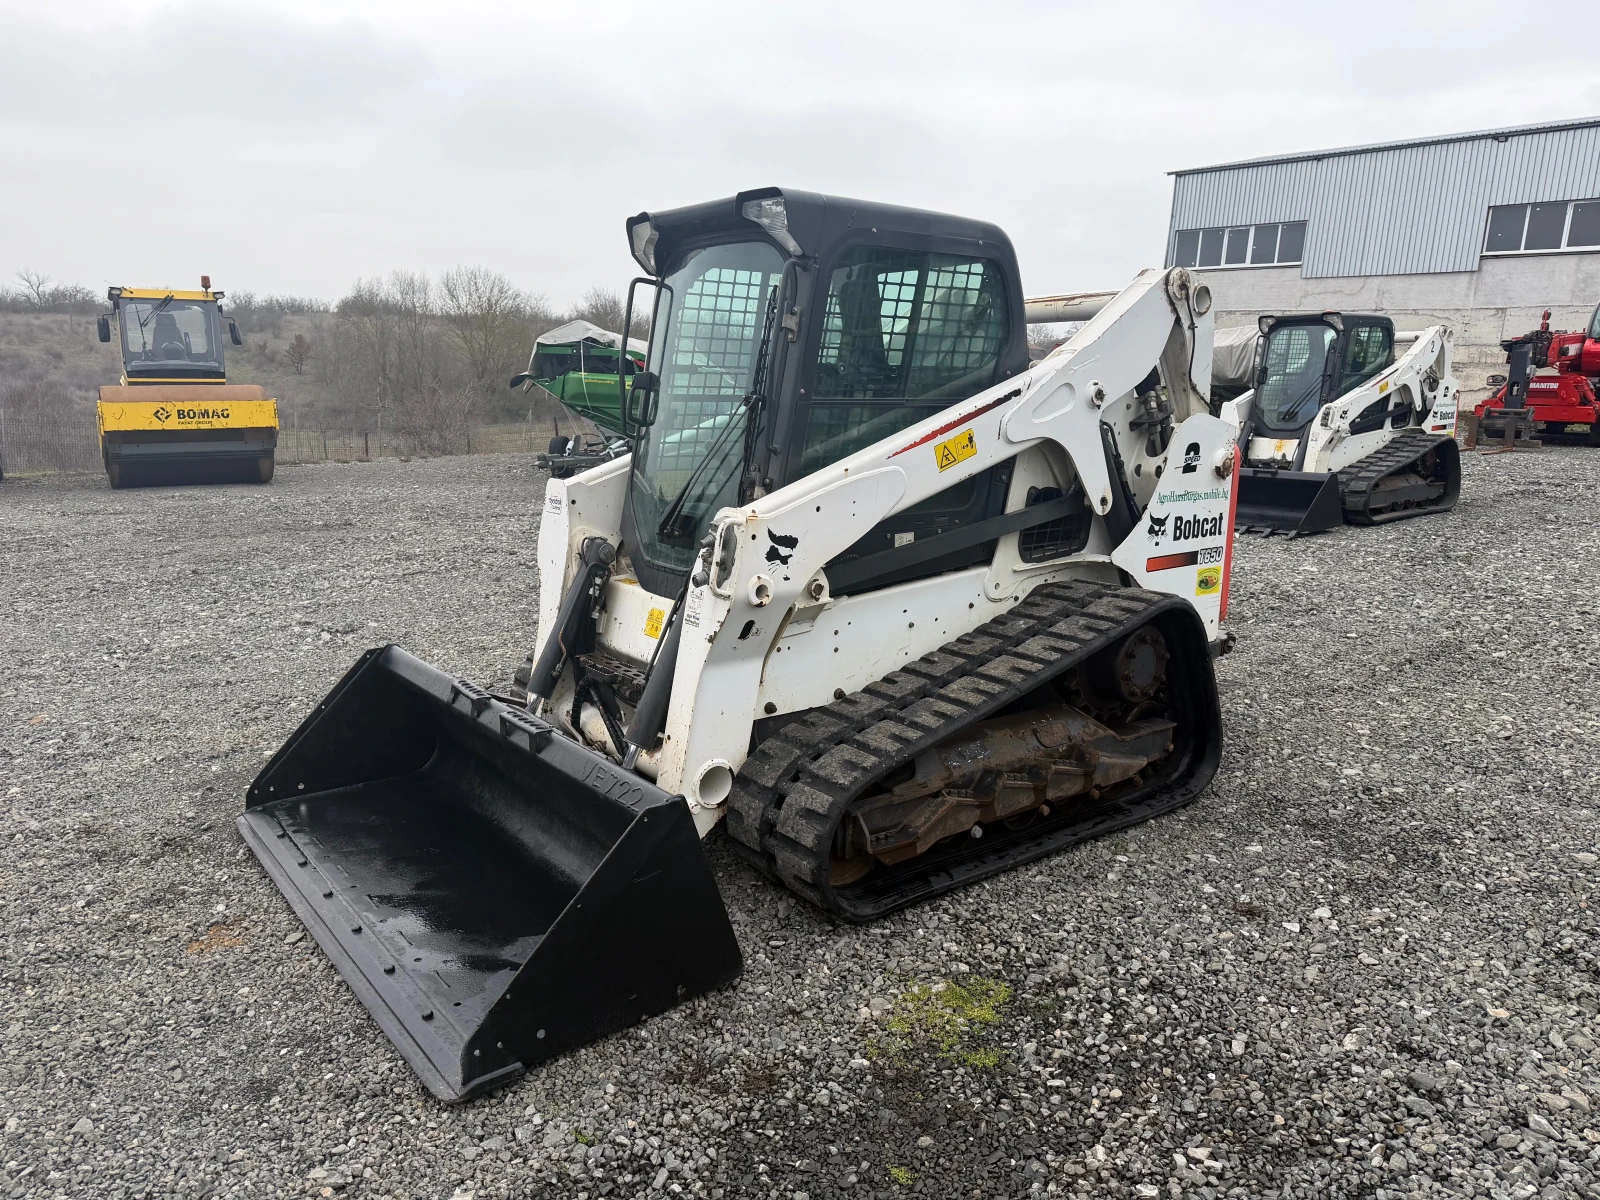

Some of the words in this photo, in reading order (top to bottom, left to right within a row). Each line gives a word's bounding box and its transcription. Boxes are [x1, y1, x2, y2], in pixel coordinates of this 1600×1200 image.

[177, 408, 230, 420] BOMAG
[1182, 442, 1200, 474] 2
[1184, 455, 1201, 463] SPEED
[1172, 512, 1223, 542] Bobcat
[1198, 546, 1224, 565] T650
